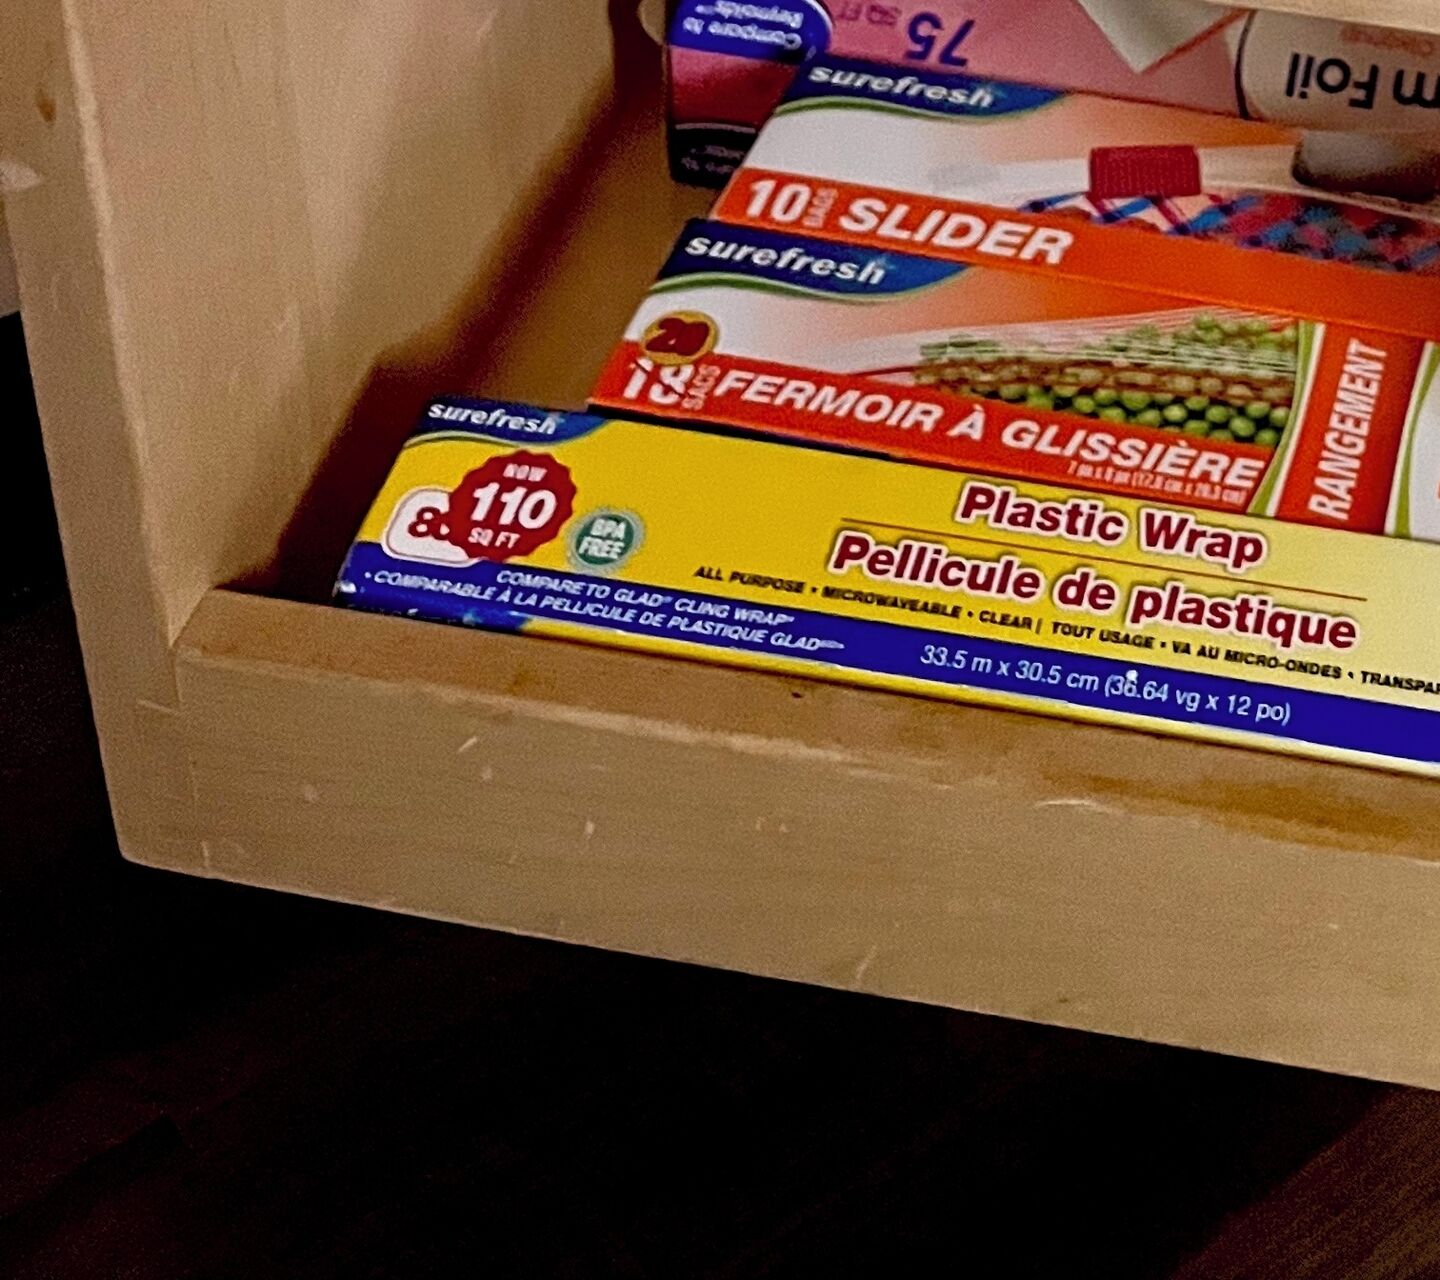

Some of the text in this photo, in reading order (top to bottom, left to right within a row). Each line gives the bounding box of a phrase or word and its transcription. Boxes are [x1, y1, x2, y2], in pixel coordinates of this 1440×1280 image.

[903, 11, 976, 68] 75
[808, 66, 996, 109] surefresh
[1284, 52, 1380, 112] Foil
[743, 178, 813, 225] 10
[837, 195, 1075, 267] SLIDER
[684, 234, 887, 287] surefresh
[427, 402, 560, 436] surefresh
[712, 369, 1268, 491] FERMOIR À GLISSIÈRE
[1306, 336, 1389, 522] RANGEMENT
[502, 463, 548, 482] NOW
[470, 481, 558, 531] 110
[958, 485, 1265, 570] Plastic Wrap
[467, 526, 521, 551] SQ FT
[577, 537, 626, 561] FREE
[373, 570, 497, 602] COMPARABLE
[514, 590, 540, 609] LA
[541, 594, 637, 623] PELLICULE
[639, 611, 666, 630] DE
[667, 615, 770, 645] PLASTIQUE
[496, 568, 731, 620] COMPARE TO CLING
[832, 534, 1358, 649] Pellicule de plastique
[694, 564, 725, 583] ALL
[727, 571, 806, 594] PURPOSE
[821, 584, 961, 620] MICROWAVEABLE
[978, 608, 1034, 632] CLEAR
[1051, 619, 1095, 642] TOUT
[1099, 626, 1155, 650] USAGE
[1171, 639, 1193, 658] VA
[1196, 643, 1221, 661] AU
[1224, 648, 1343, 680] MICRO-ONDES
[920, 643, 967, 671] 33.5
[970, 653, 994, 676] m
[996, 658, 1012, 678] x
[1015, 658, 1063, 687] 30.5
[1066, 670, 1101, 693] cm
[1175, 686, 1201, 713] vg
[1204, 692, 1219, 710] x
[1226, 693, 1251, 716] 12
[1254, 700, 1292, 727] po)
